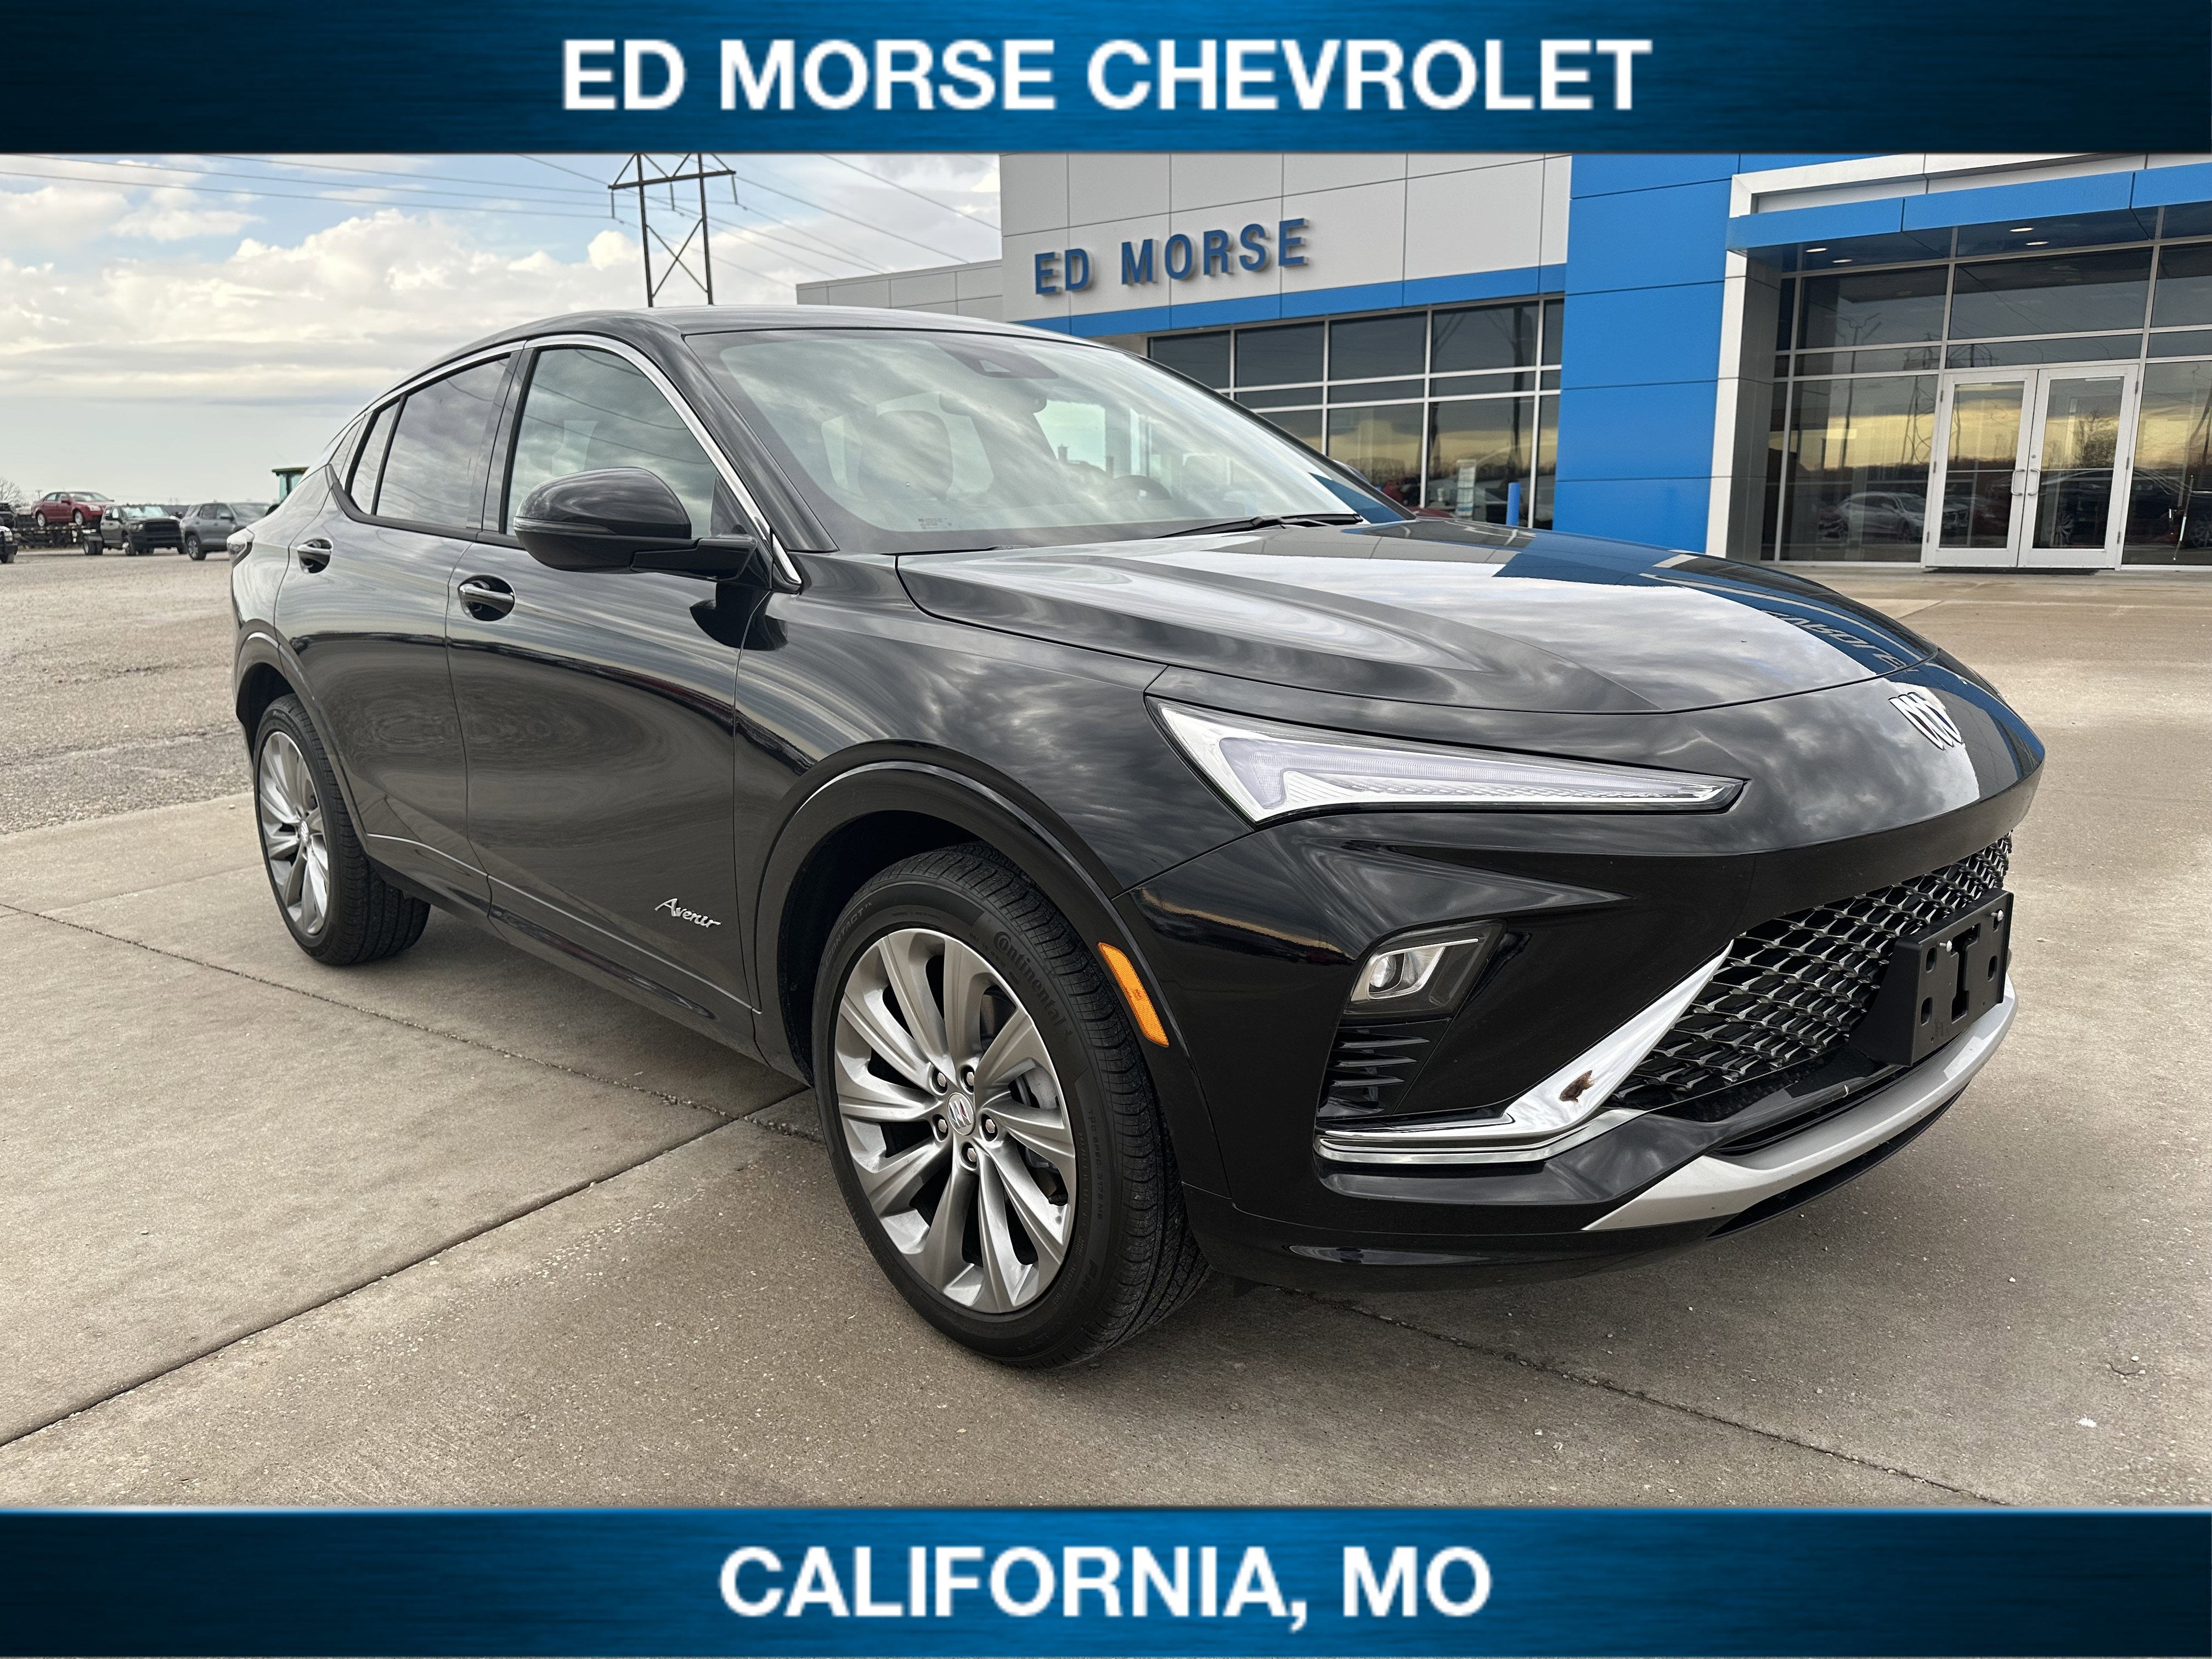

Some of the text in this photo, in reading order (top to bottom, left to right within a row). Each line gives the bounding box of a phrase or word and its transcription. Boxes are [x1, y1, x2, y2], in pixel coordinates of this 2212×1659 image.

[1035, 218, 1307, 295] ED MORSE
[654, 898, 721, 928] Avenir
[994, 931, 1066, 1026] Continental
